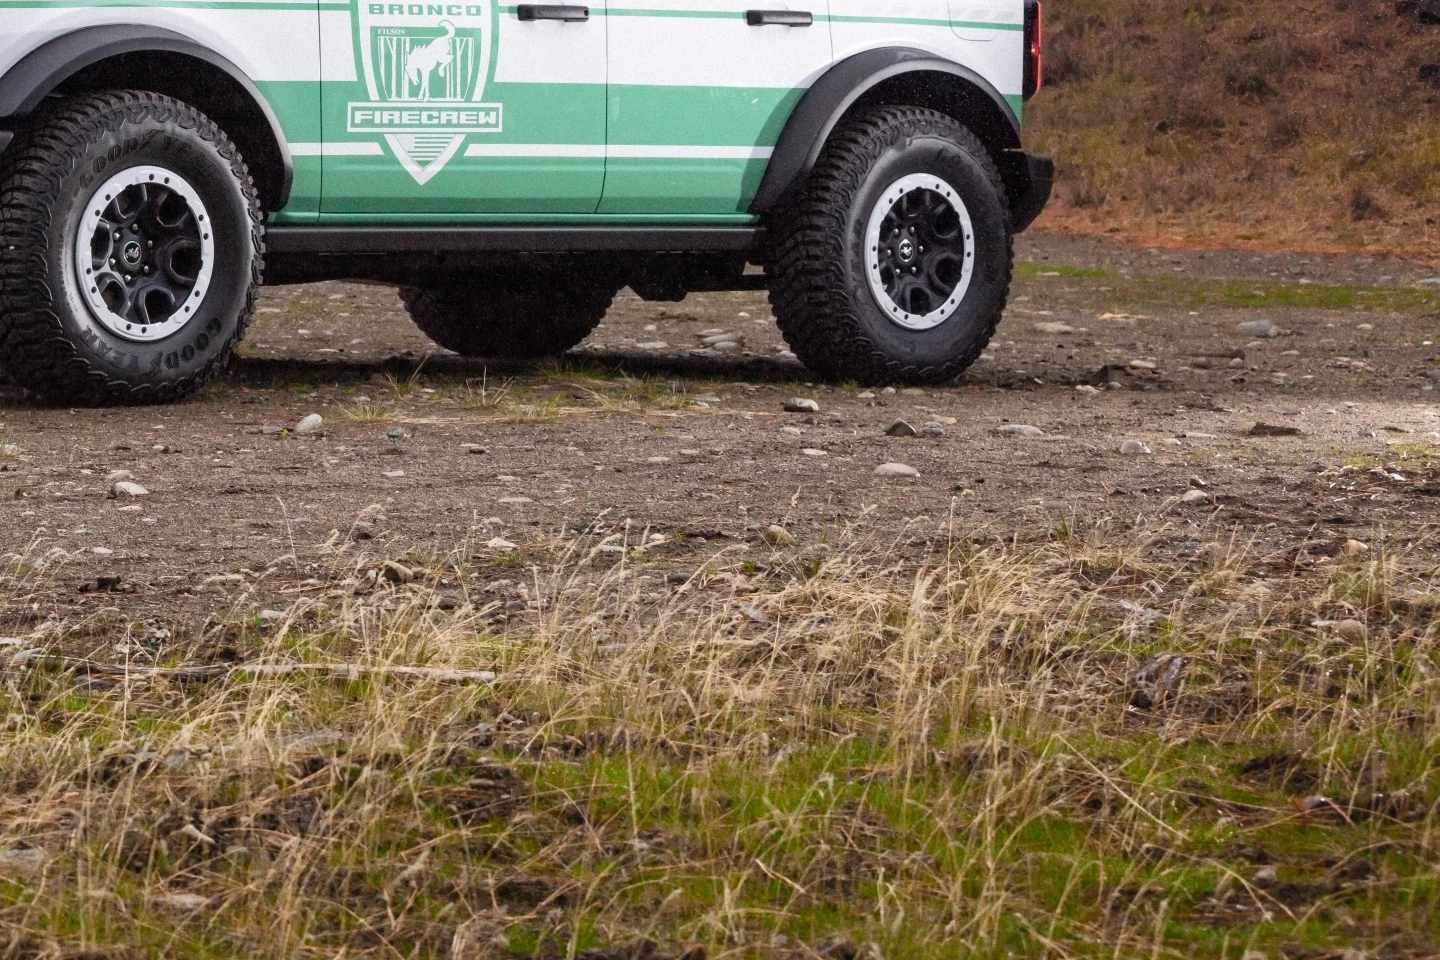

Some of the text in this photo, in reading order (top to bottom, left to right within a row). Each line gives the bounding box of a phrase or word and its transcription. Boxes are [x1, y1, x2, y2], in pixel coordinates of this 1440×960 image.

[368, 3, 482, 17] BRONCO
[377, 28, 407, 36] FILSON
[353, 110, 498, 126] FIRECREW
